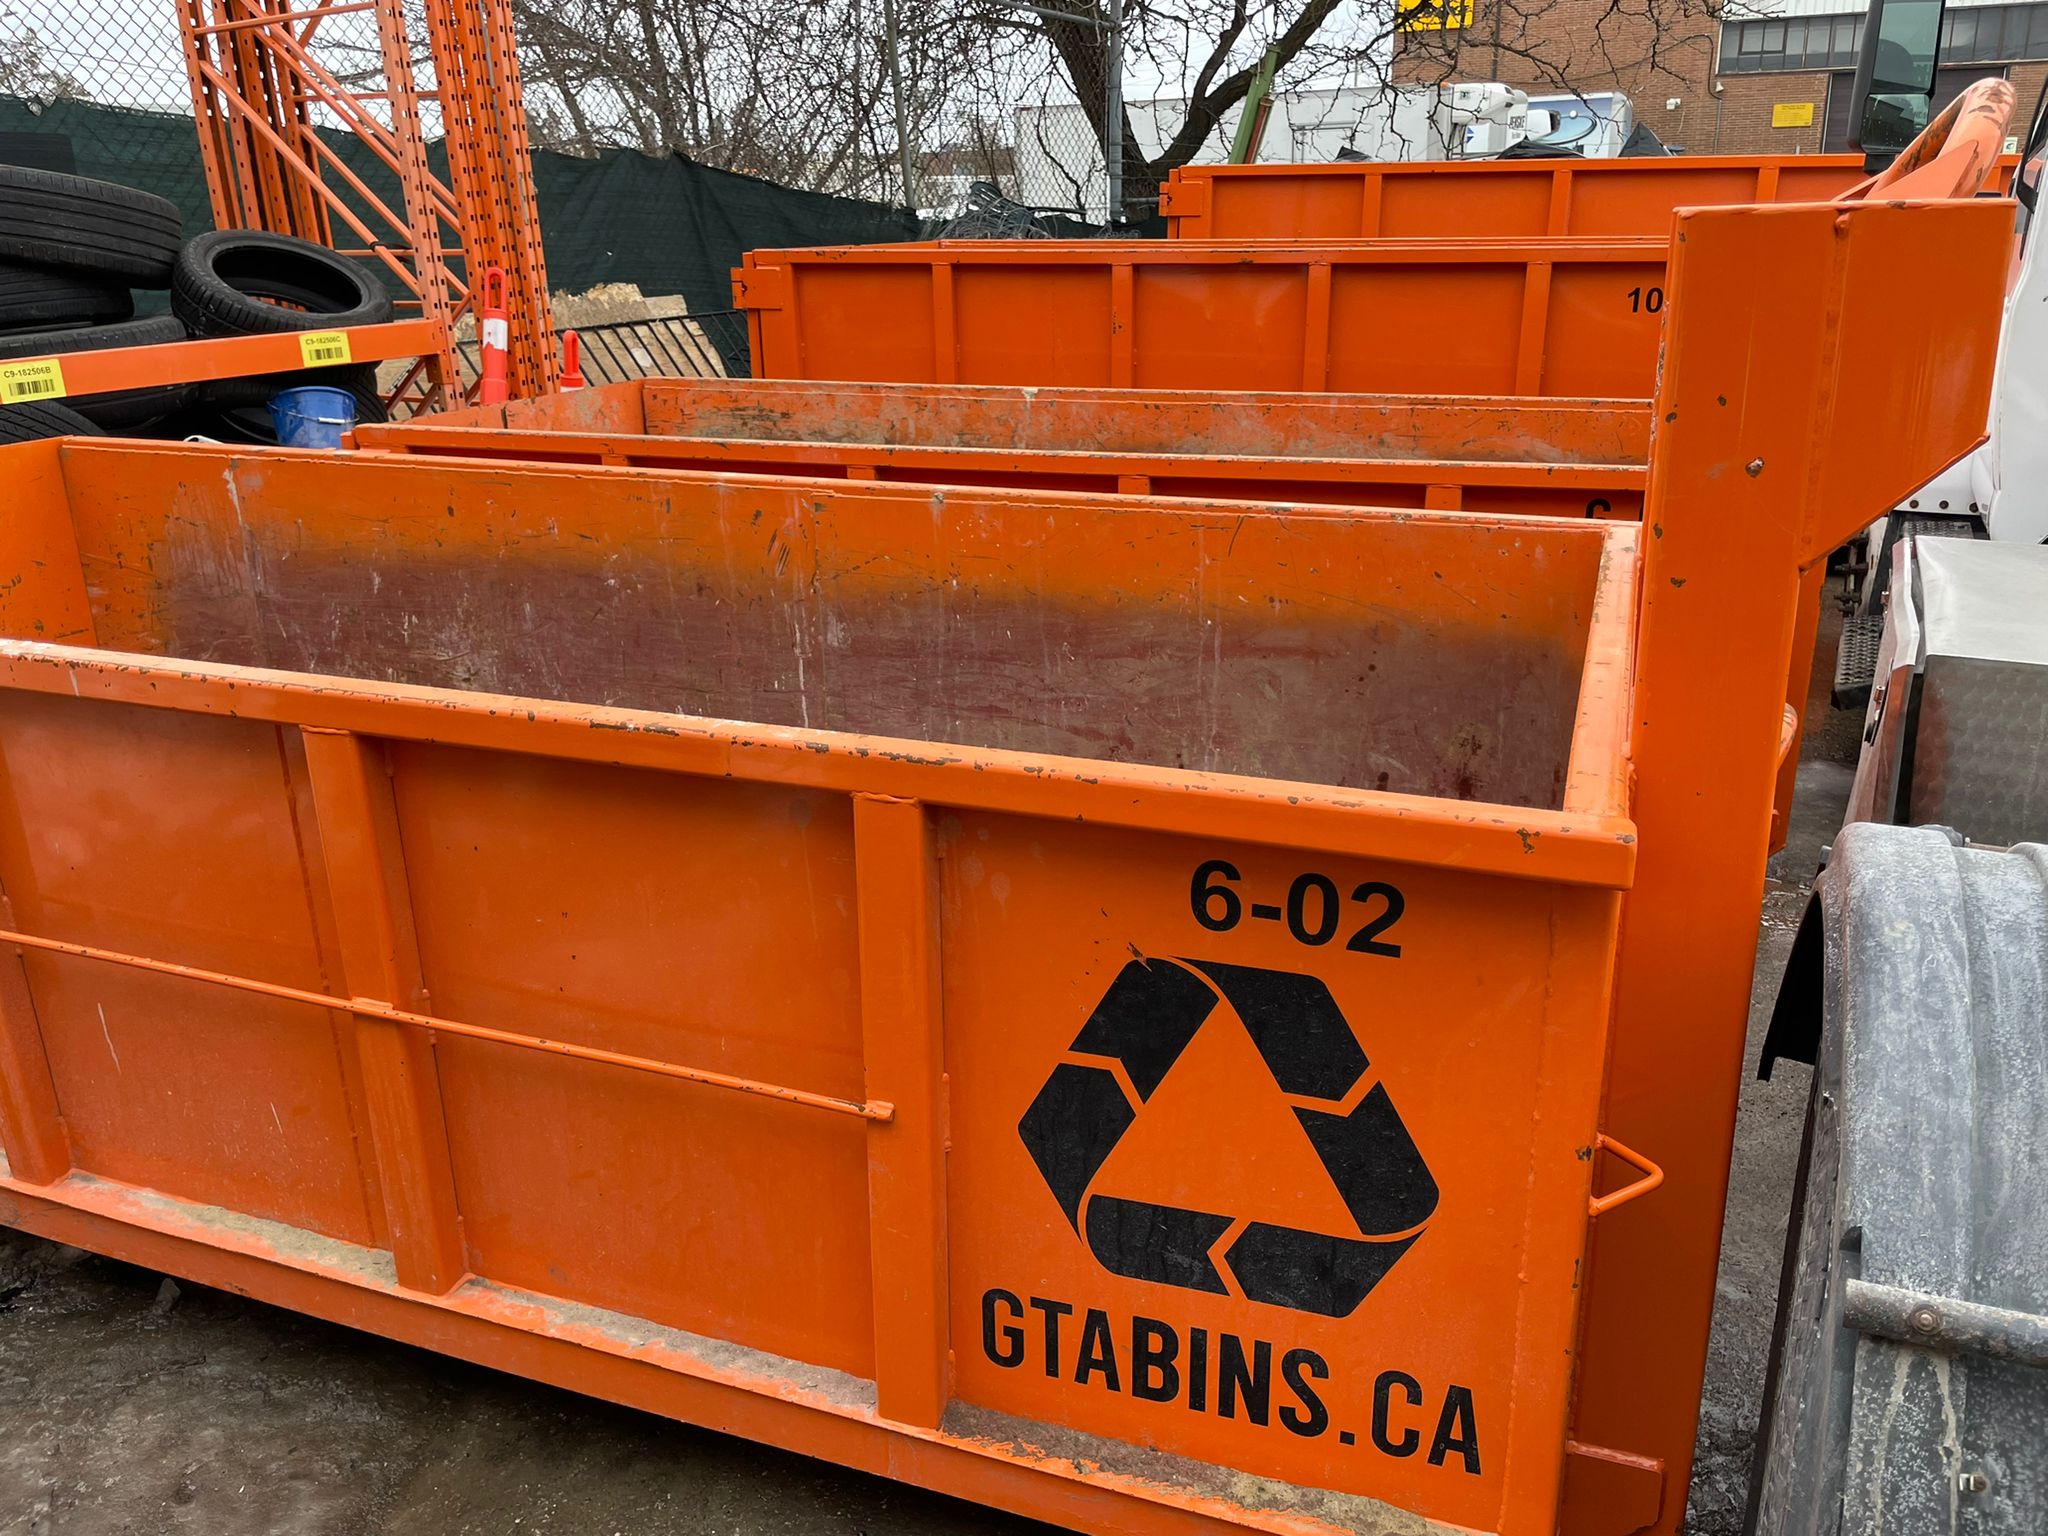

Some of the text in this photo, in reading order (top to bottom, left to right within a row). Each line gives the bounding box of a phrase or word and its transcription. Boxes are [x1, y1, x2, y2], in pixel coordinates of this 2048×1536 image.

[1627, 287, 1664, 314] 10
[3, 366, 52, 378] C9-182506B
[1189, 859, 1406, 959] 6-02
[980, 1288, 1482, 1476] GTABINS.CA
